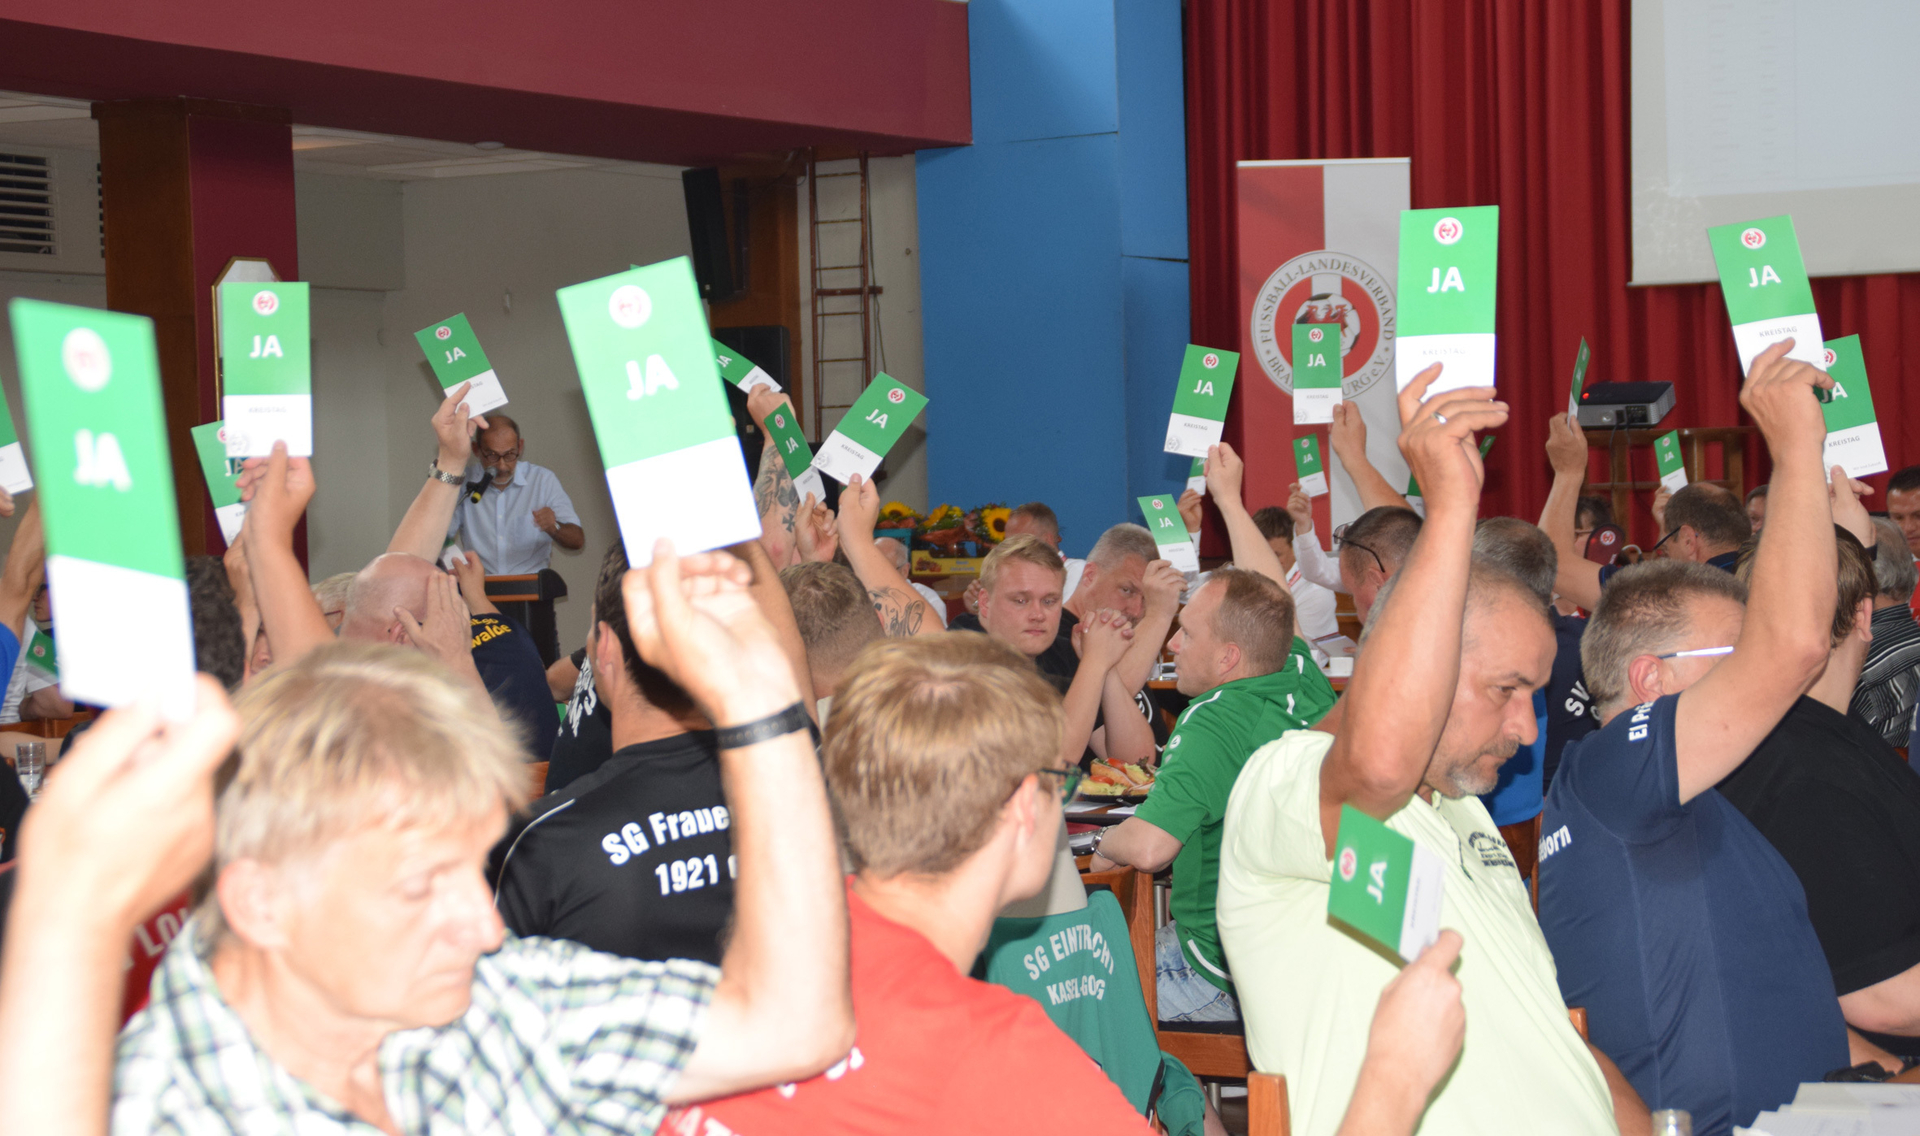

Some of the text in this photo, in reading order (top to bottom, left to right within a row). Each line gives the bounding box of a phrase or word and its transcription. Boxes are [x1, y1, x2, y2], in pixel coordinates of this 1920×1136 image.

[1427, 266, 1466, 294] JA
[1749, 264, 1782, 288] JA
[1259, 258, 1395, 344] FUSSBALL-LANDESVERBAND
[1759, 326, 1798, 338] KREISTAG
[249, 334, 284, 358] JA
[445, 346, 467, 364] JA
[716, 354, 732, 368] JA
[1307, 353, 1327, 367] JA
[625, 353, 680, 401] JA
[1193, 379, 1215, 396] JA
[1821, 381, 1849, 403] JA
[866, 408, 889, 429] JA
[1184, 422, 1208, 431] KREISTAG
[785, 436, 799, 454] JA
[841, 443, 865, 460] KREISTAG
[1828, 435, 1860, 447] KREISTAG
[74, 428, 133, 493] JA
[1302, 453, 1314, 464] JA
[1664, 451, 1675, 463] JA
[1159, 516, 1174, 528] JA
[1564, 680, 1590, 717] SV
[601, 805, 730, 866] SG Fraue
[655, 853, 719, 896] 1921
[1366, 861, 1388, 905] JA
[1023, 945, 1051, 981] SG
